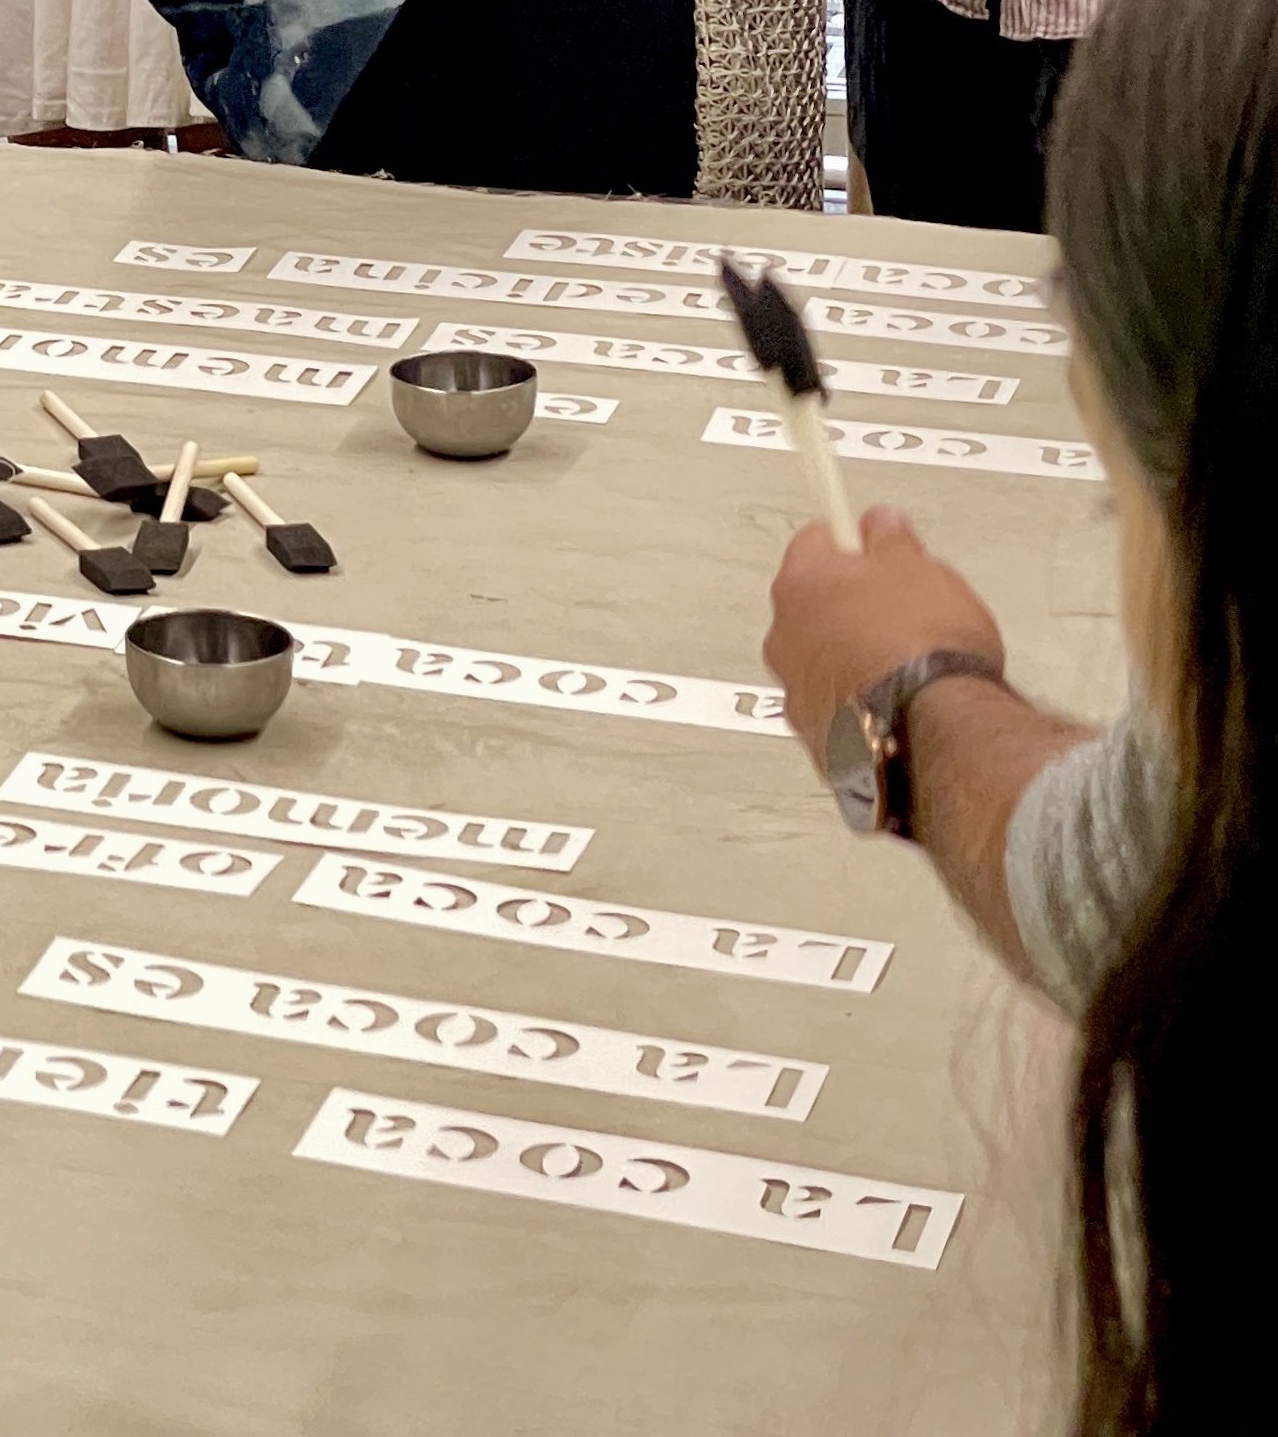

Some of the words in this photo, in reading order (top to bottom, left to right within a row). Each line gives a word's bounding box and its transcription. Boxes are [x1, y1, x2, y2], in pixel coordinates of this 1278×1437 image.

[136, 245, 234, 269] es
[529, 234, 831, 275] resiste
[859, 265, 1038, 298] oca
[451, 328, 557, 350] es
[825, 305, 1069, 345] coca
[879, 368, 1002, 400] La
[396, 647, 678, 705] coca
[39, 761, 571, 855] memoria
[336, 864, 651, 945] coca
[57, 948, 205, 1002] es
[709, 926, 870, 983] La
[250, 981, 581, 1065] coca
[635, 1042, 806, 1109] La
[342, 1108, 691, 1197] coca
[757, 1176, 933, 1254] La
